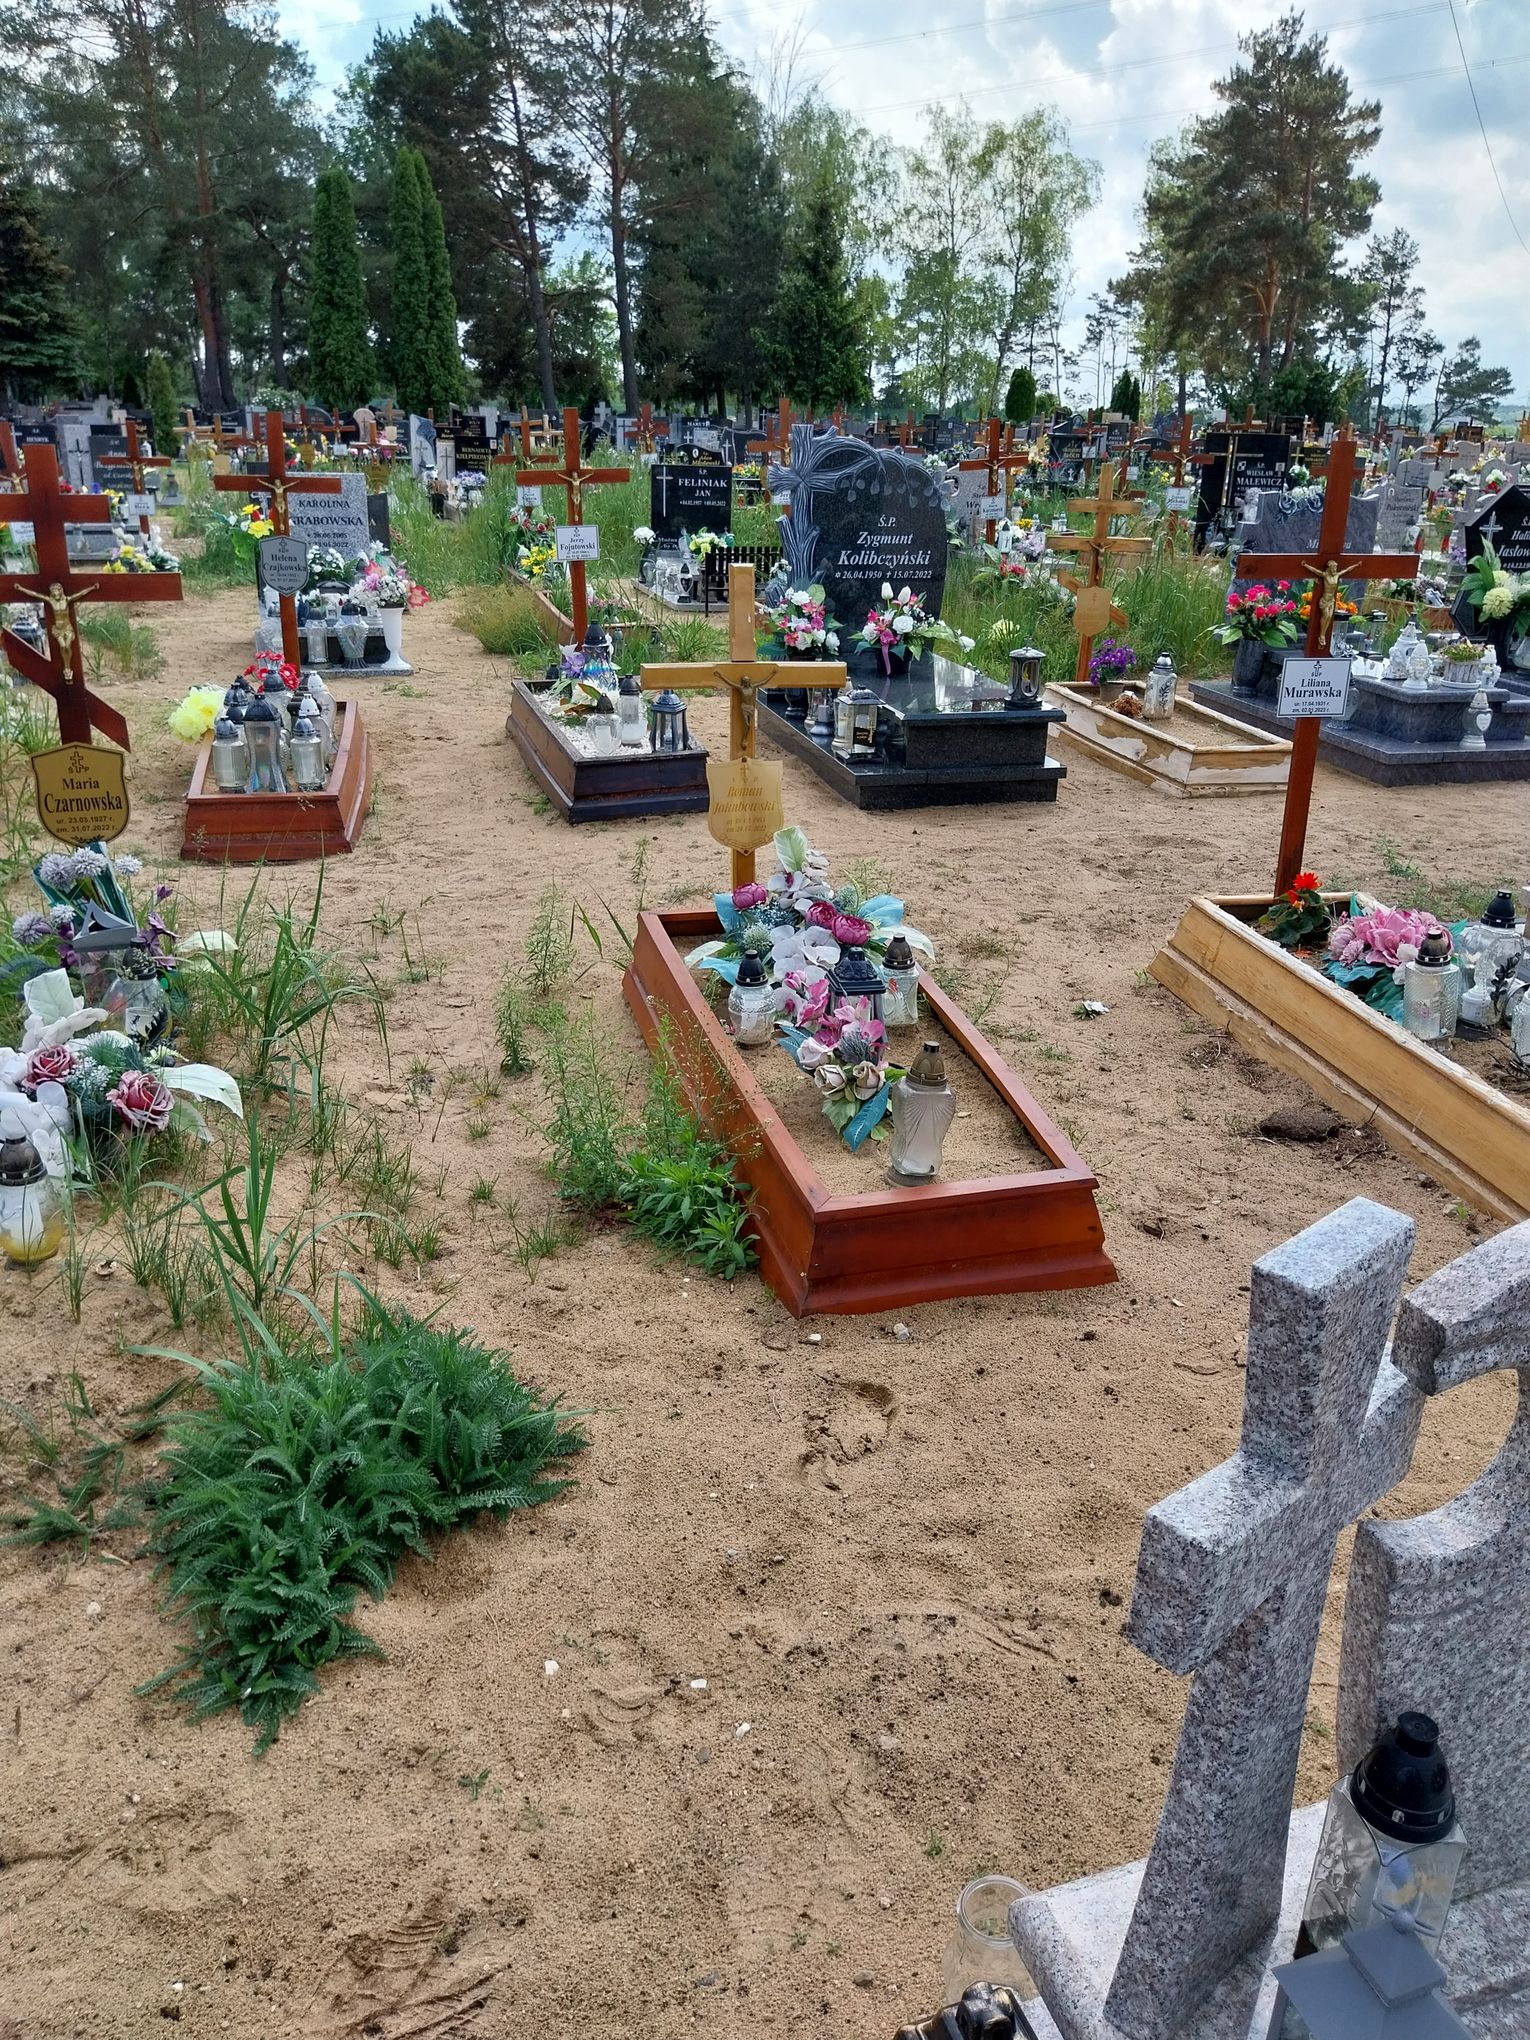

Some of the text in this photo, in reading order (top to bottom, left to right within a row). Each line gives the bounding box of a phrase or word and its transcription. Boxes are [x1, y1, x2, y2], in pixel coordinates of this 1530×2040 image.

[678, 478, 728, 488] FELINIAK
[1236, 477, 1282, 486] MALEWICZ
[694, 489, 711, 497] JAN
[298, 500, 351, 509] KAROLINA
[878, 514, 896, 527] Ś.P.
[856, 531, 914, 548] Zygmunt
[560, 543, 596, 551] Fojutowski
[271, 554, 298, 562] Helena
[837, 550, 931, 569] Kolibczyński
[262, 563, 307, 573] Czajkowska
[842, 571, 933, 579] 26.04.1950 15.07.2022
[1300, 678, 1331, 688] Liliana
[1284, 687, 1342, 698] Murawska
[62, 778, 100, 790] Maria
[727, 786, 763, 797] Roman
[44, 791, 123, 814] Czarnowska
[713, 800, 776, 815] Jakubowski
